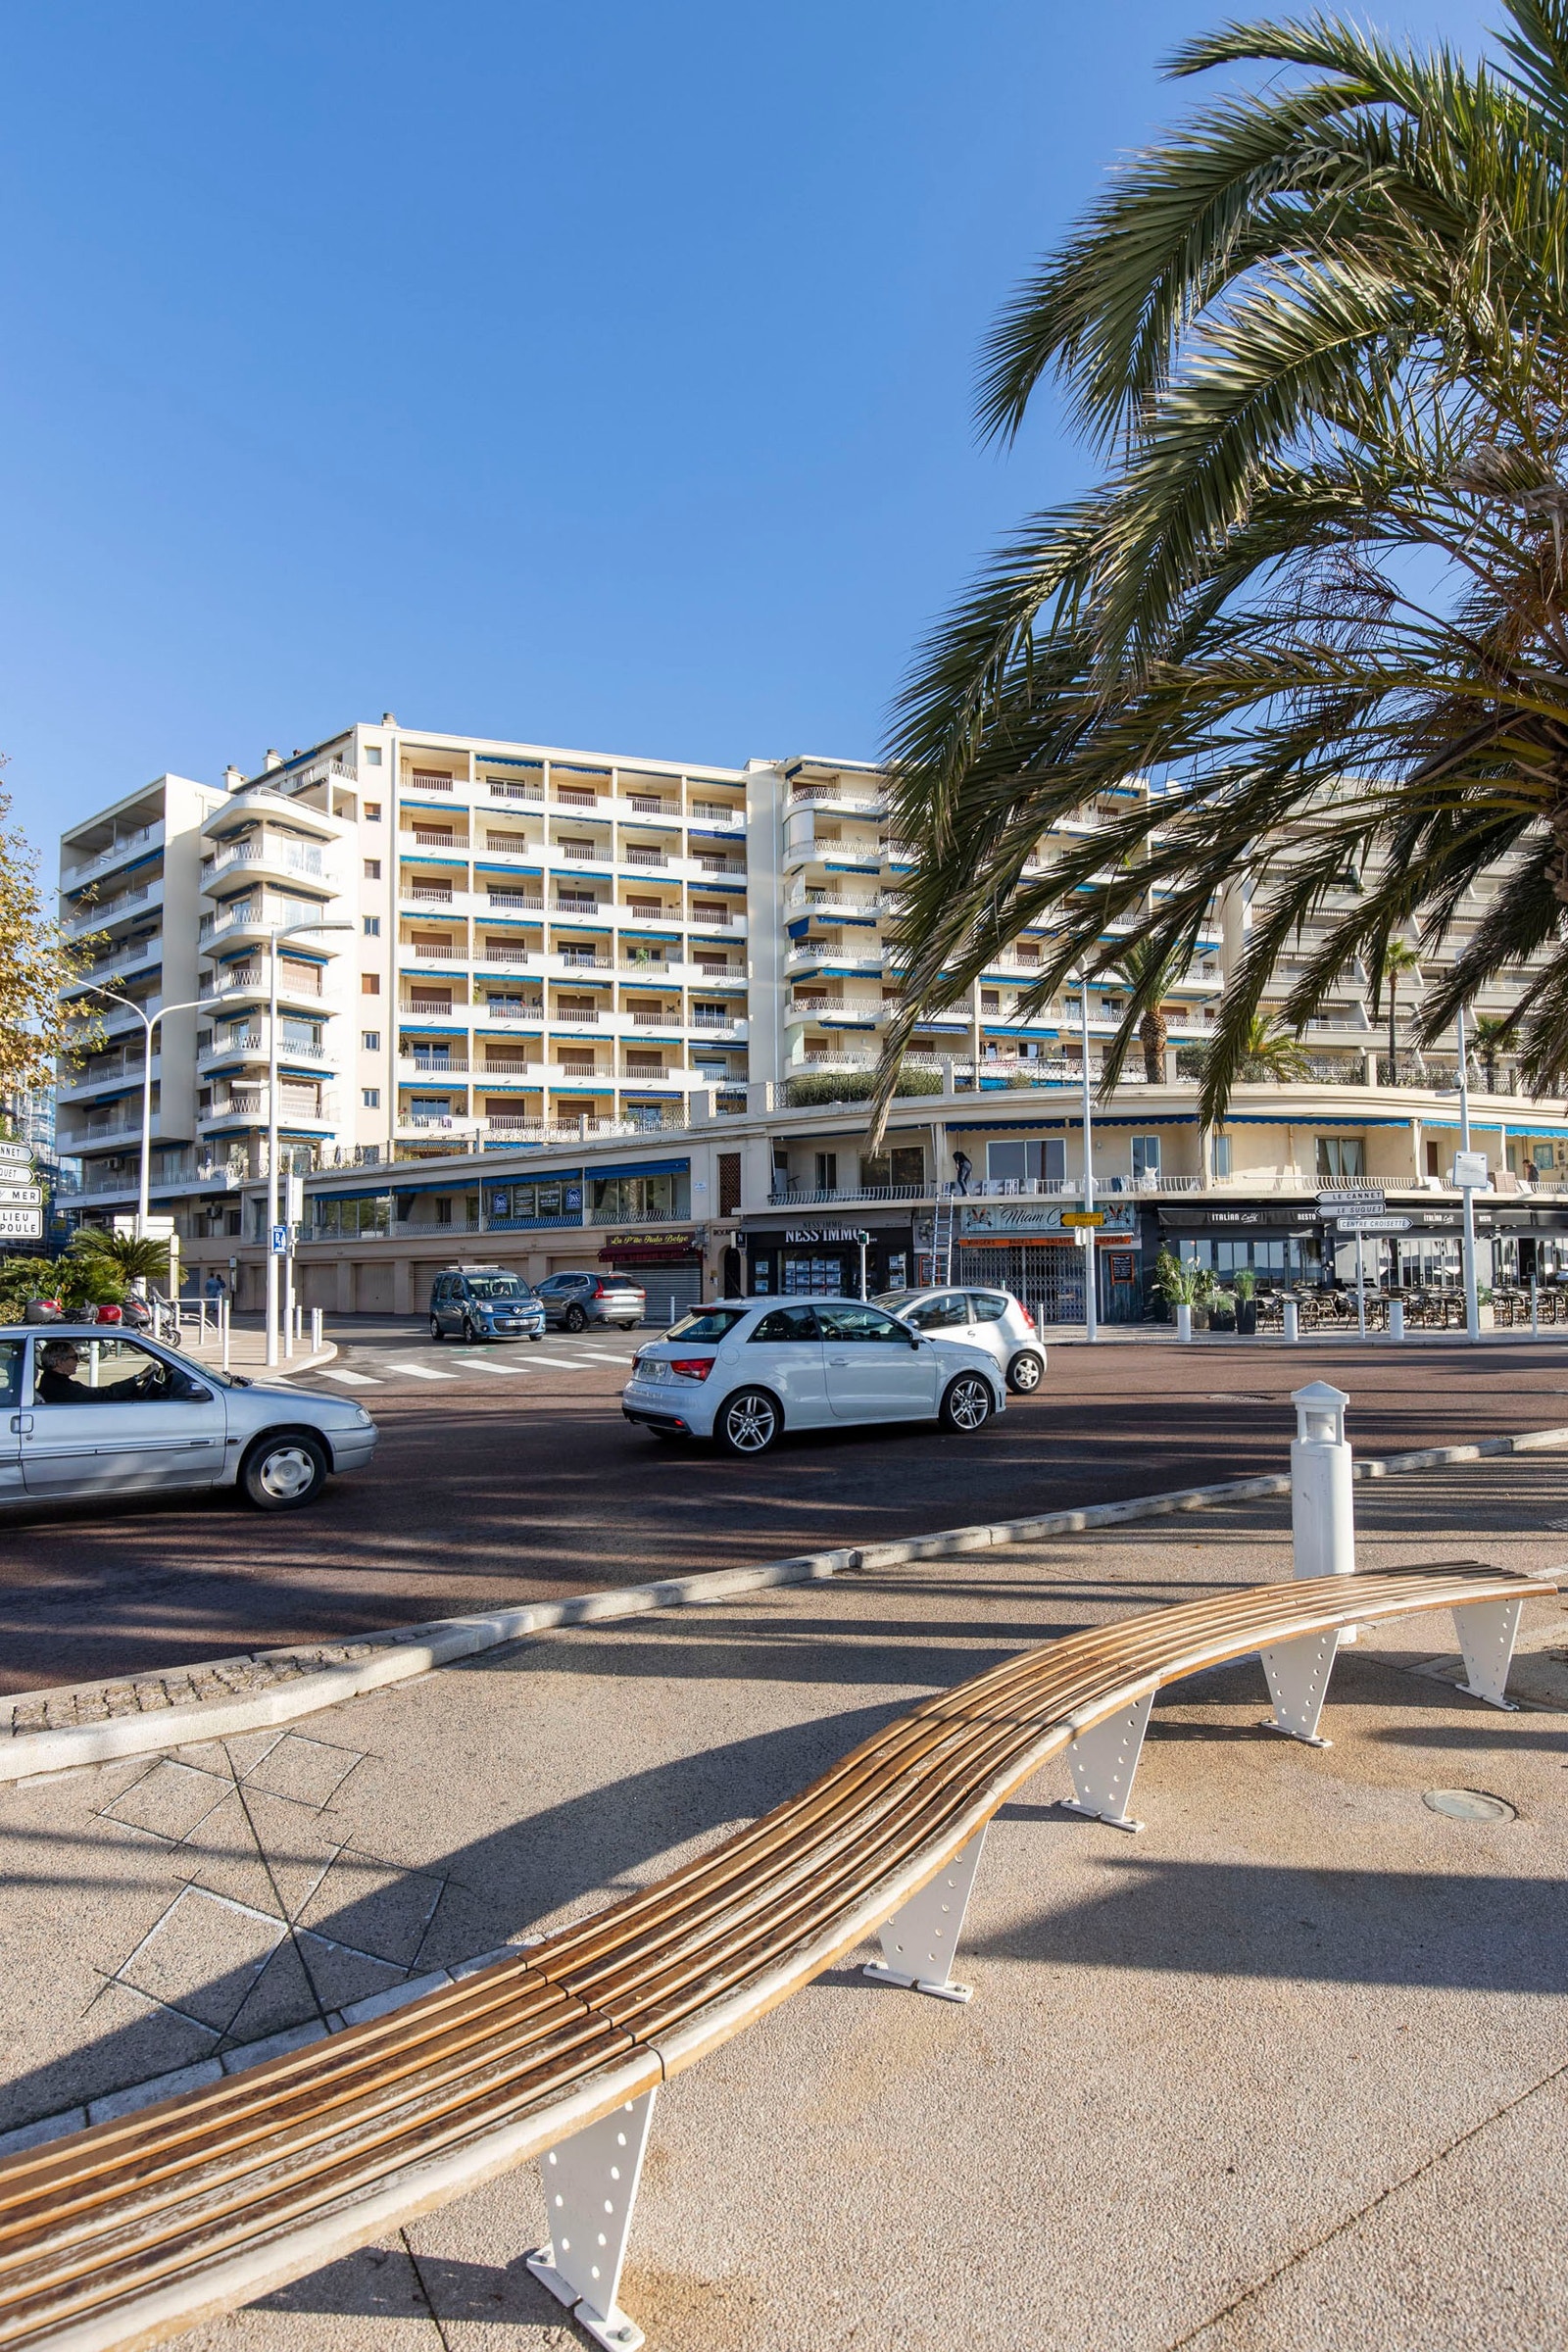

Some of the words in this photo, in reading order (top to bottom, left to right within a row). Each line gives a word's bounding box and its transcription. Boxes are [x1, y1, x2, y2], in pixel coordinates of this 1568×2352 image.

[12, 1191, 36, 1200] MER
[2, 1212, 29, 1222] LIEU
[1001, 1208, 1046, 1226] Miam
[0, 1223, 36, 1233] POULE
[611, 1236, 622, 1245] La
[664, 1234, 689, 1244] Belge
